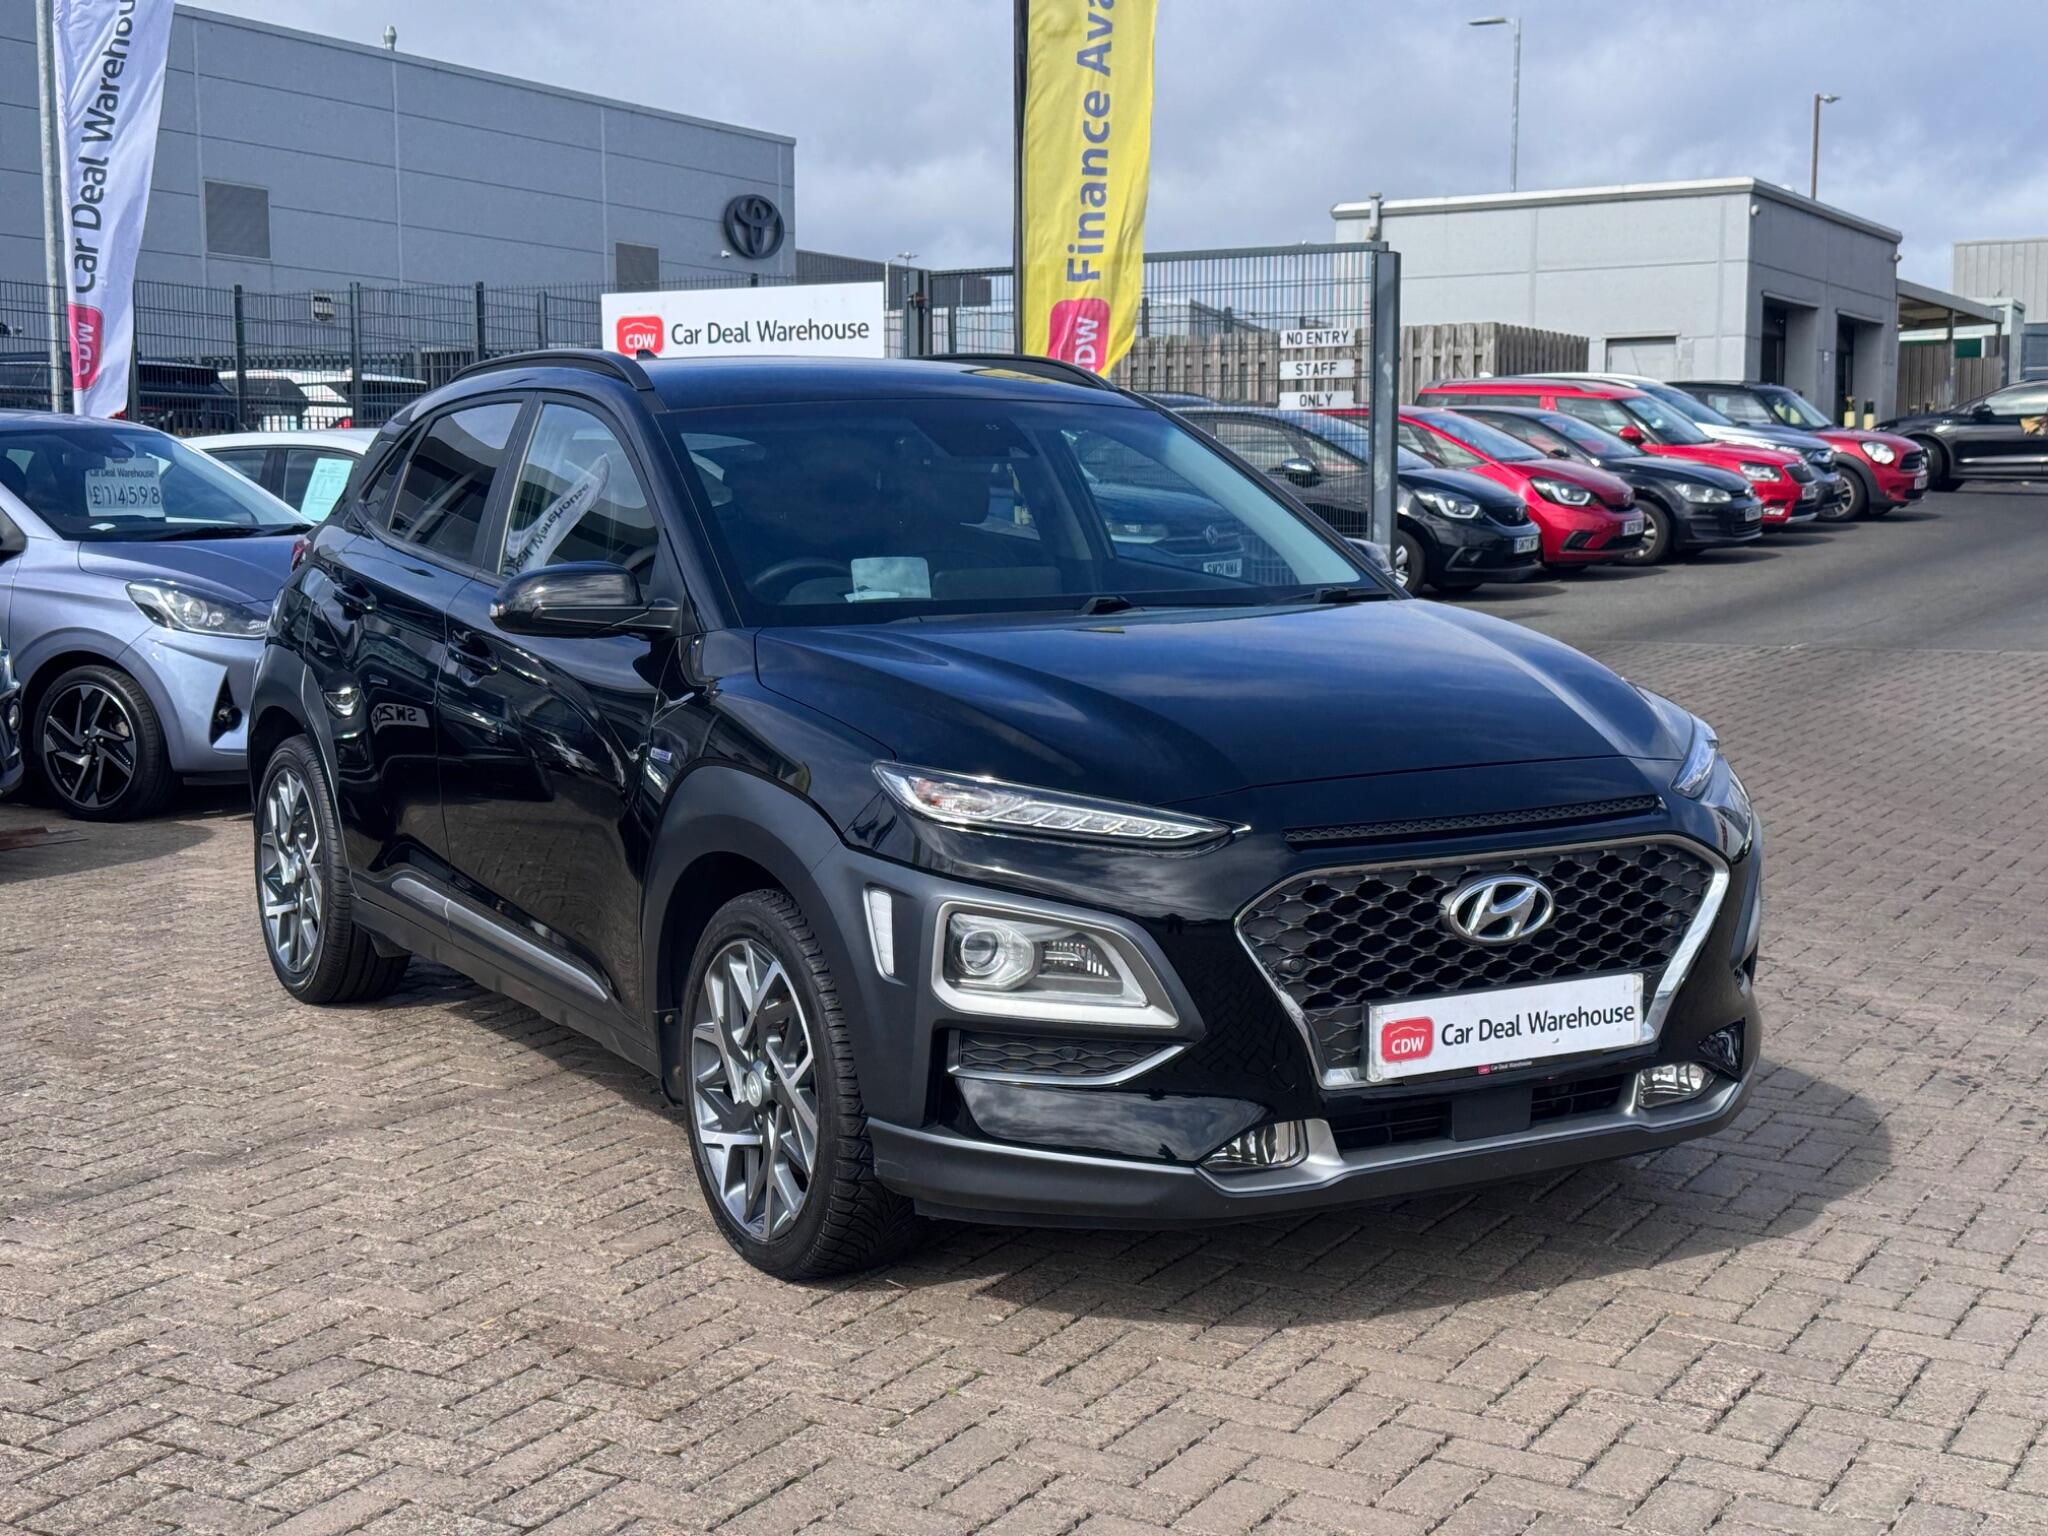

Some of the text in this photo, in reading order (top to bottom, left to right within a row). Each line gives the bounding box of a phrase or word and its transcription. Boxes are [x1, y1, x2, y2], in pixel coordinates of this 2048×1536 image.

[71, 156, 110, 231] Deal
[1067, 90, 1111, 282] Finance
[74, 238, 99, 293] Car
[625, 333, 657, 349] CDW
[671, 318, 870, 345] Car Deal Warehouse
[1286, 330, 1349, 345] NO ENTRY
[1295, 361, 1338, 376] STAFF
[1299, 393, 1333, 407] ONLY
[118, 467, 155, 478] Warehouse
[92, 486, 160, 505] £14598
[1441, 1005, 1635, 1047] Car Deal Warehouse
[1391, 1035, 1425, 1055] CDW
